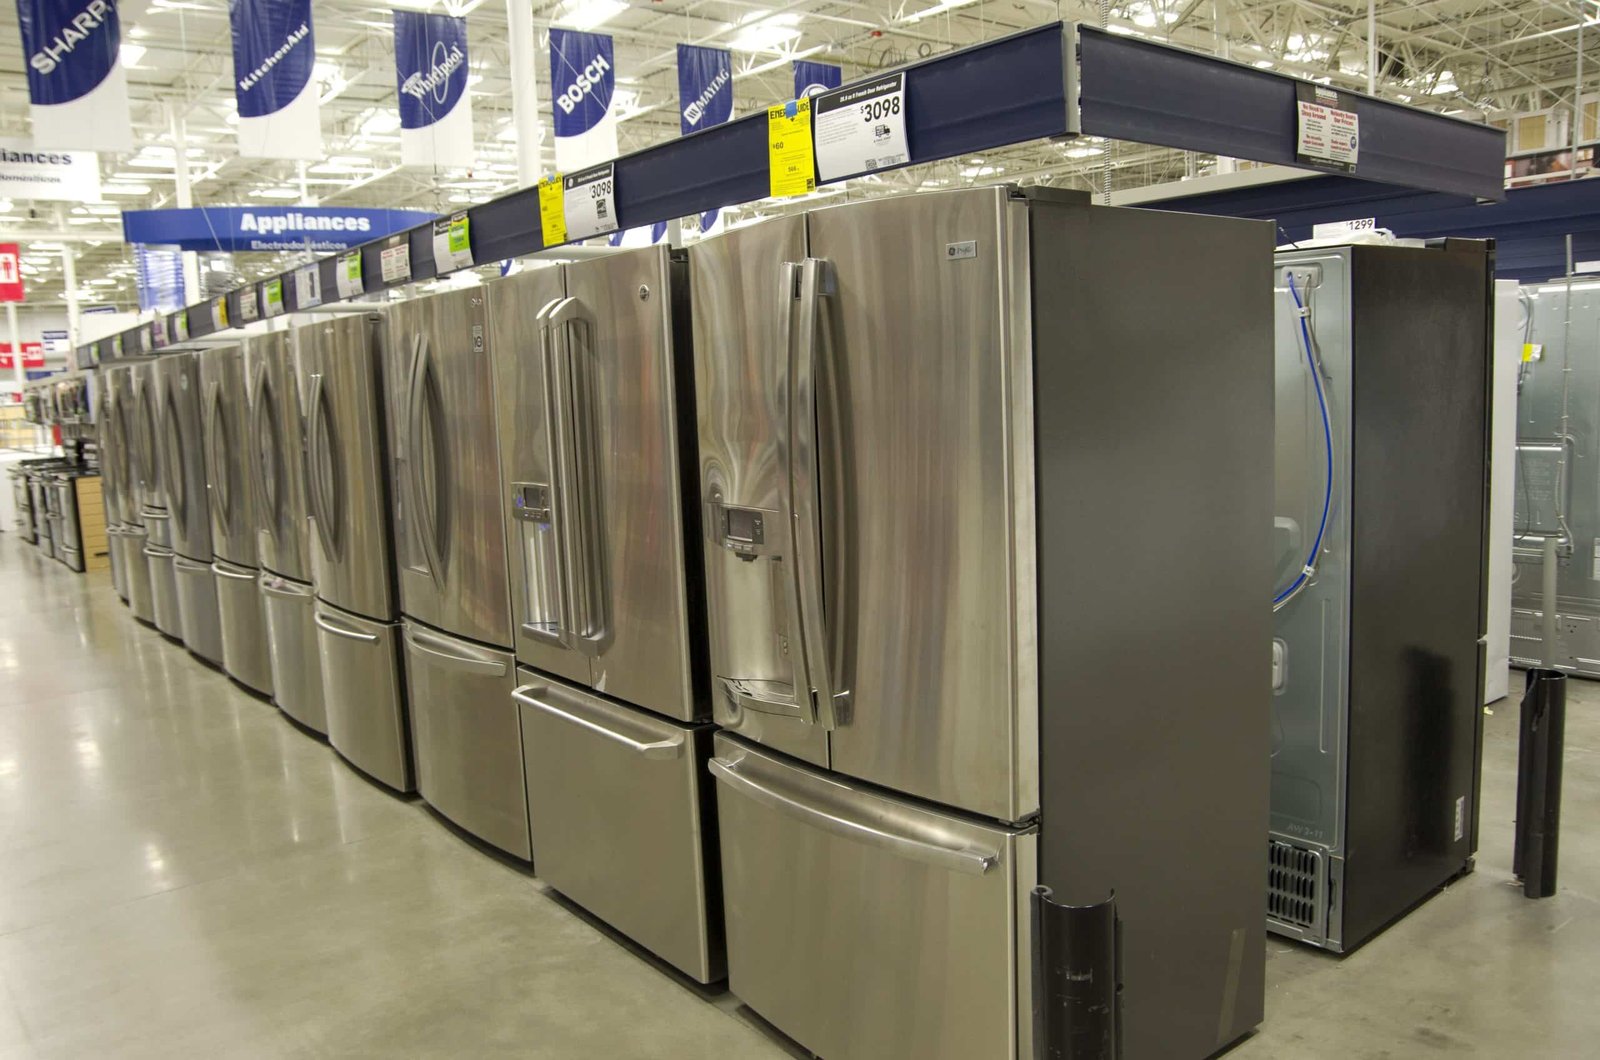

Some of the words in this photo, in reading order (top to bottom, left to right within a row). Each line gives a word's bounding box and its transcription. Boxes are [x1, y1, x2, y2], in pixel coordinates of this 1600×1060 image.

[30, 0, 107, 75] SHARP
[239, 24, 309, 92] KitchenAid
[403, 45, 464, 98] Whirlpool
[557, 54, 610, 115] BOSCH
[695, 69, 729, 111] MAYTAG
[860, 96, 900, 122] $3098
[240, 213, 371, 235] Appliances
